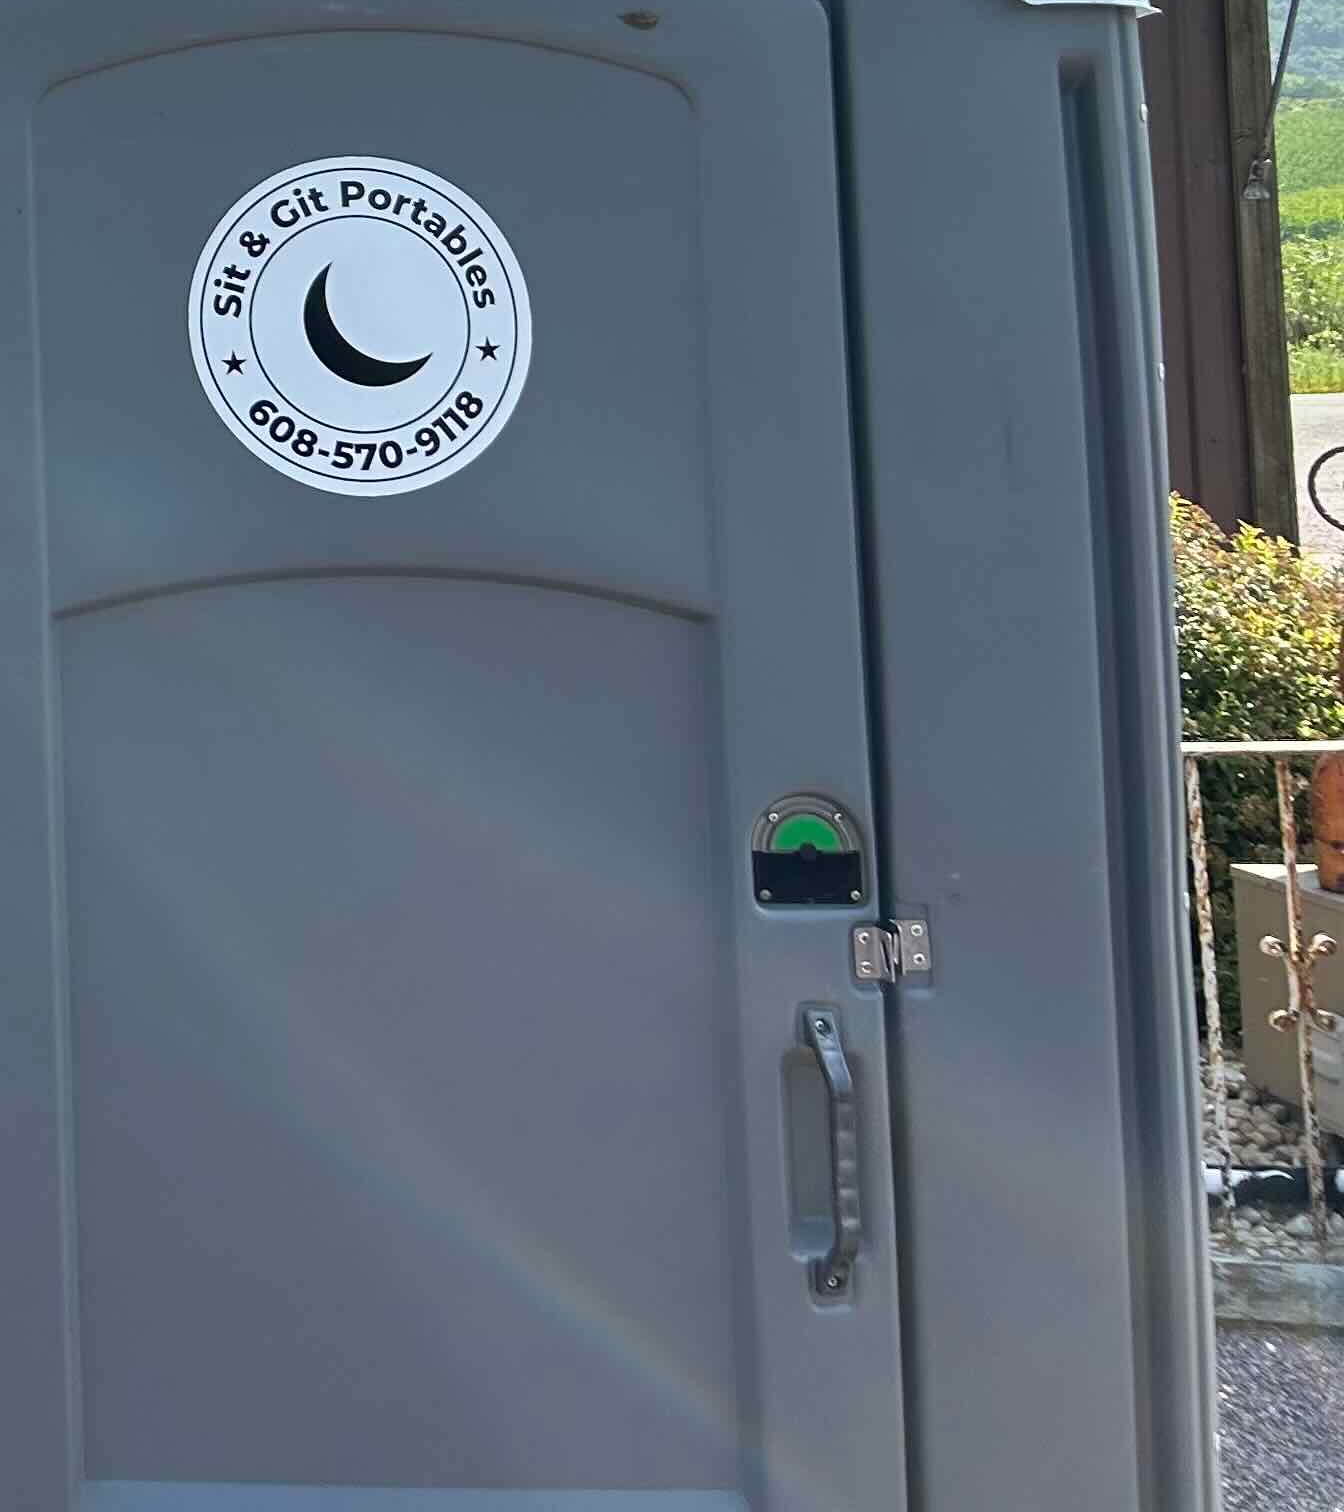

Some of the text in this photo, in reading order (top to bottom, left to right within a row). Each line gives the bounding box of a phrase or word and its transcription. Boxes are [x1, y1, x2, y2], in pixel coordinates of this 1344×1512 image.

[214, 181, 496, 318] Sit & Git Portables
[249, 391, 484, 471] 608-570-9118
